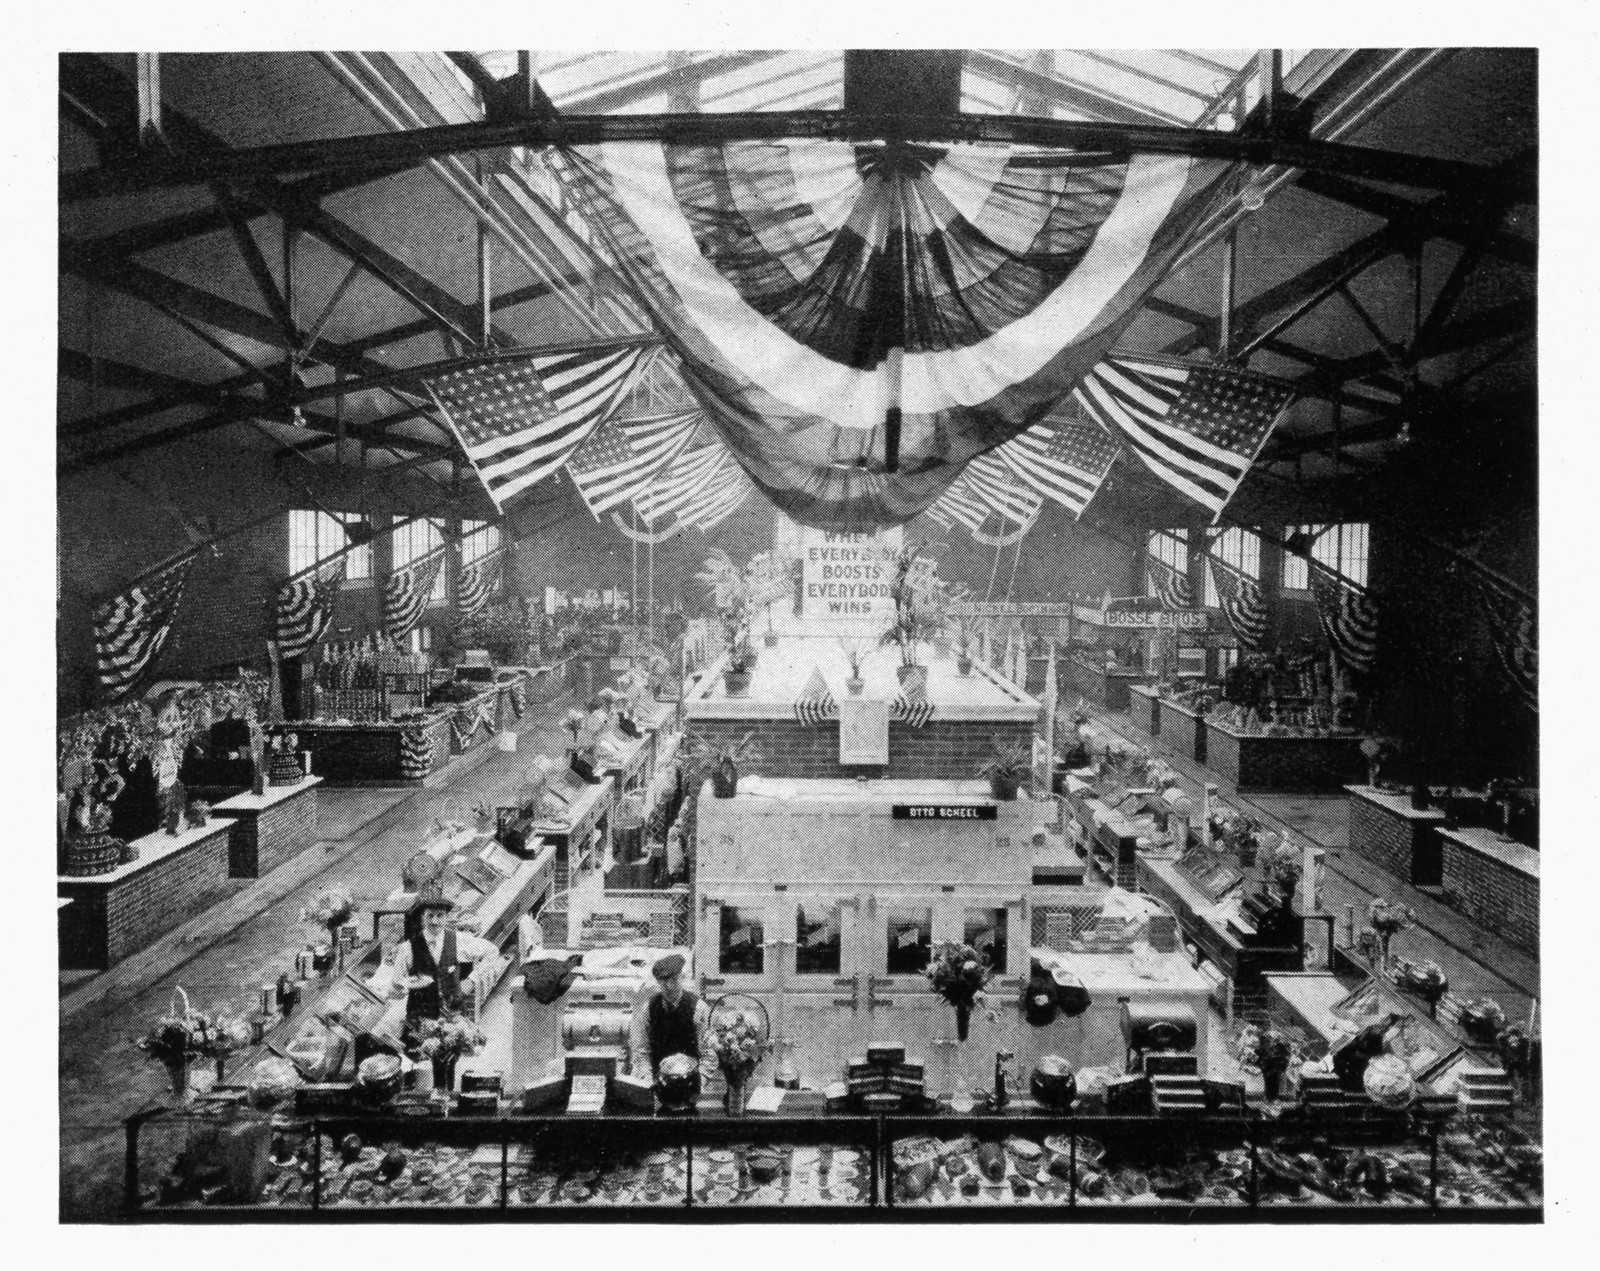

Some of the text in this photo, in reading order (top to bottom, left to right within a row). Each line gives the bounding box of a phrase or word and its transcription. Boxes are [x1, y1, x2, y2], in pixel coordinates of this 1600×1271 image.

[822, 565, 881, 580] BOOSTS
[807, 583, 894, 598] EVERYBOD
[829, 601, 872, 614] WINS
[1109, 611, 1155, 625] BOSSE
[909, 807, 980, 818] OTTO SCHEEL
